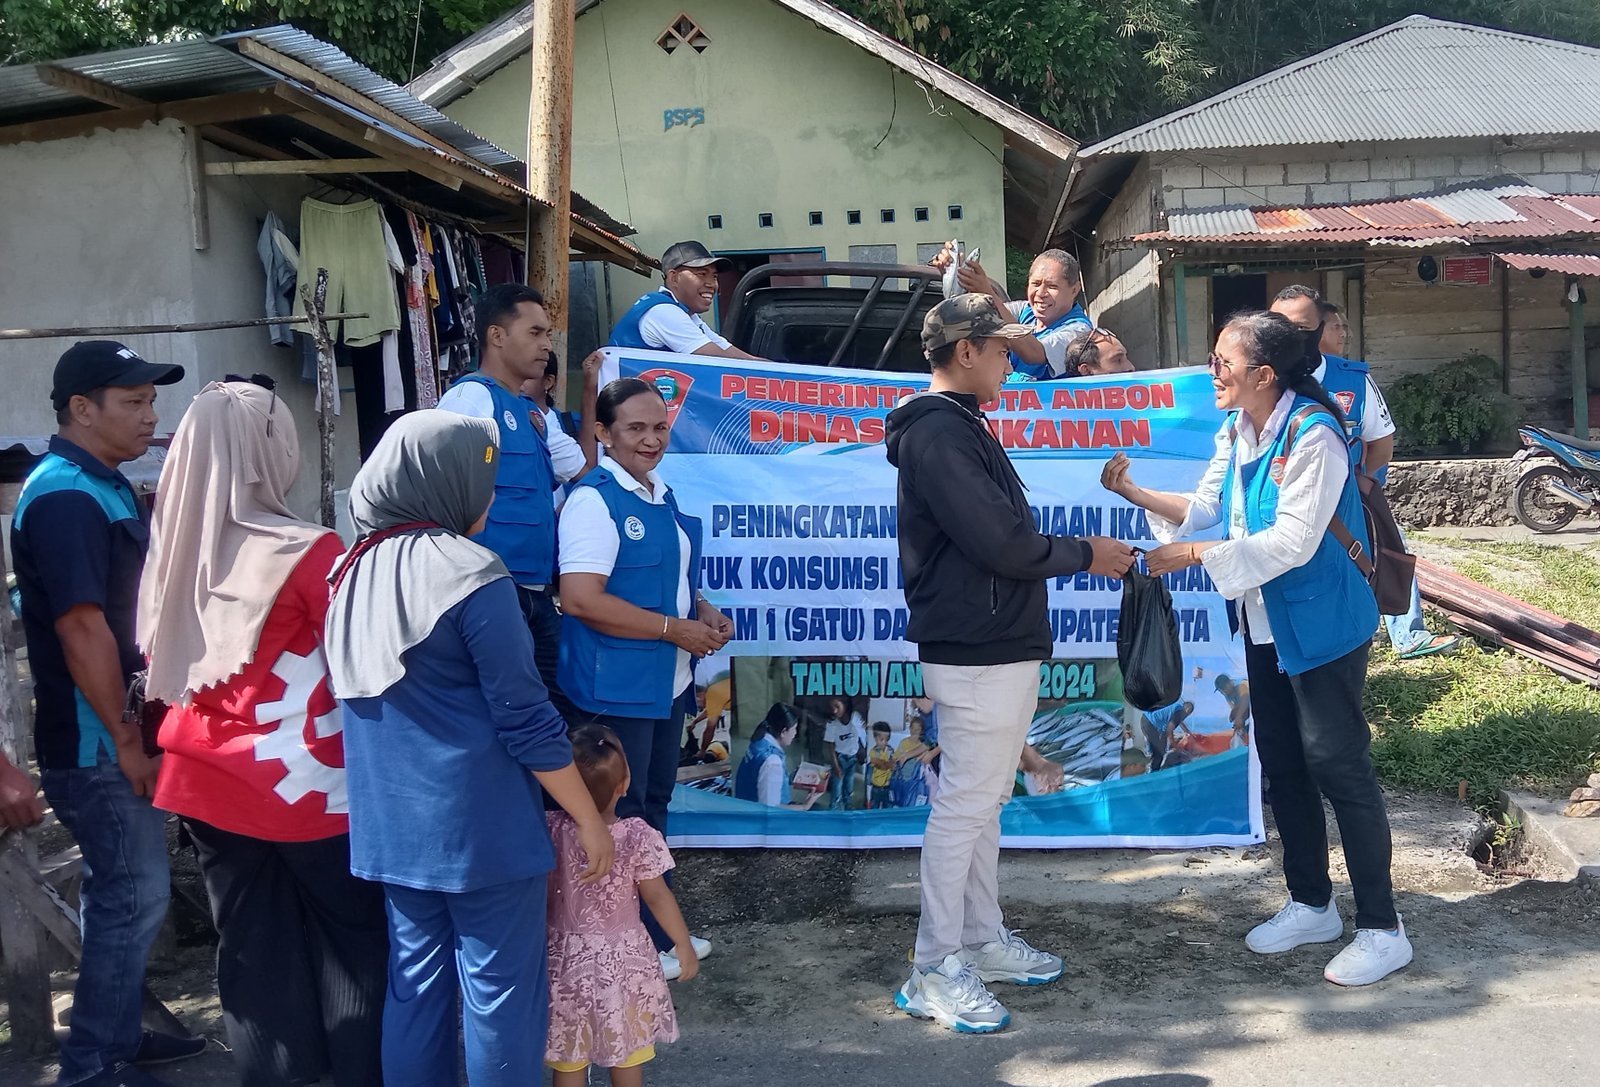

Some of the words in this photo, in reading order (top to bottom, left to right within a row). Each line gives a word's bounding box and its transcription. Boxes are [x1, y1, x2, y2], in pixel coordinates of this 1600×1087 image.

[720, 373, 929, 410] PEMERINT
[1052, 382, 1175, 412] AMBON
[749, 410, 886, 445] DINAS
[712, 503, 897, 539] PENINGKATAN
[1109, 506, 1158, 541] IKA
[751, 555, 889, 591] KONSUMSI
[766, 607, 776, 641] 1
[784, 607, 866, 641] (SATU)
[791, 661, 881, 698] TAHUN
[1038, 662, 1097, 699] 2024
